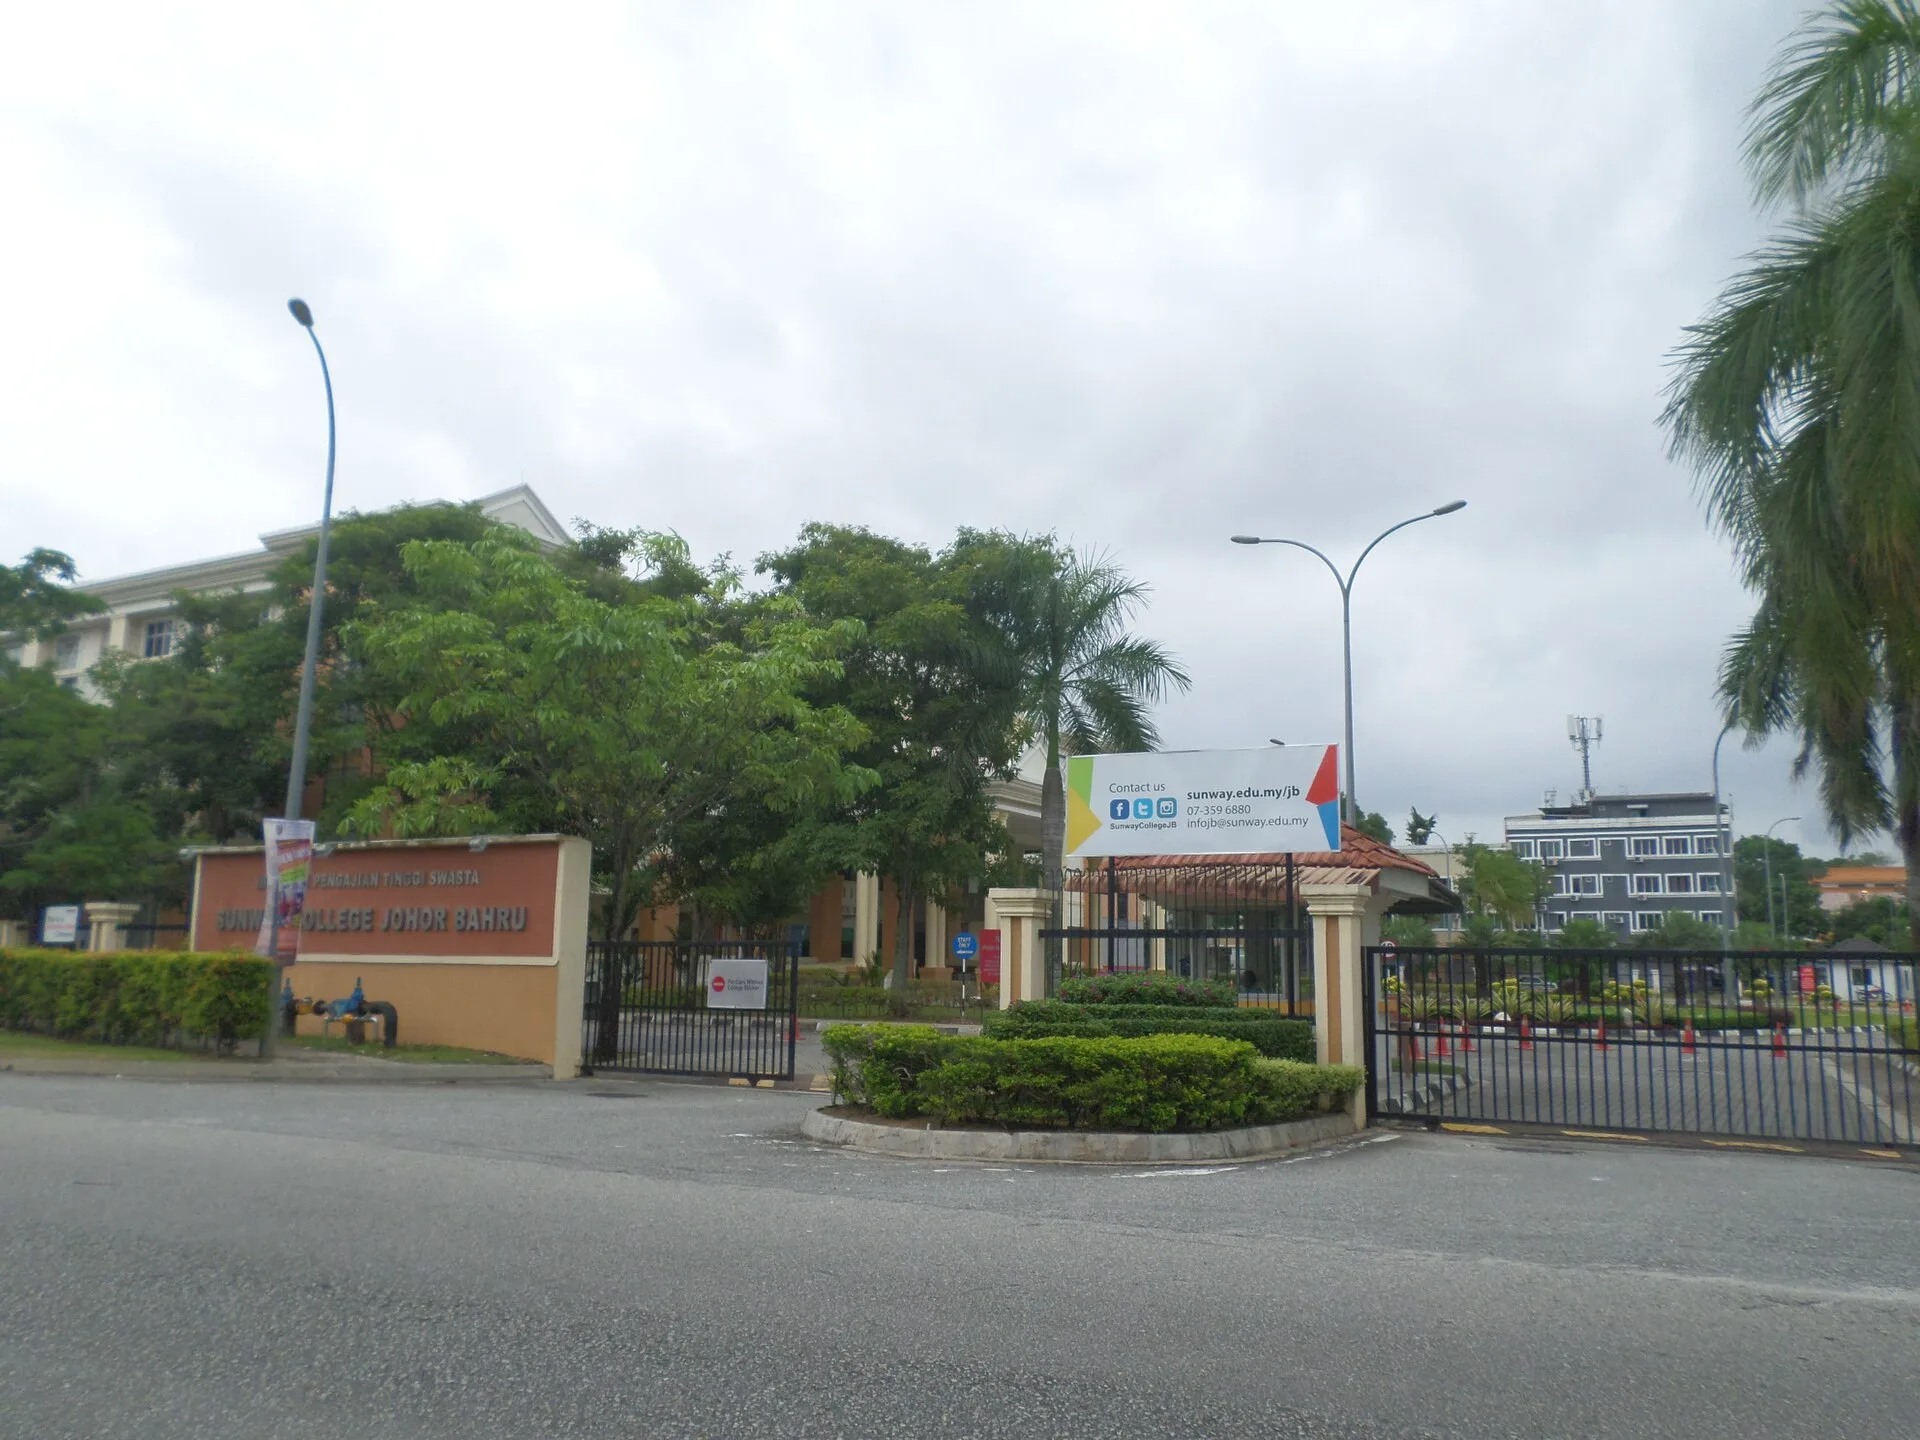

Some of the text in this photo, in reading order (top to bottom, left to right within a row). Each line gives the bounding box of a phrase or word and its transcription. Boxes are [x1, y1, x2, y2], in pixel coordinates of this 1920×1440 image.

[1109, 782, 1166, 794] Contact us
[1187, 786, 1300, 801] sunway.edu.my/jb
[1187, 804, 1251, 816] 07-359 6880
[1110, 820, 1177, 831] SunwayCollegeJB
[1187, 816, 1309, 830] infojb@sunway.edu.my
[313, 872, 381, 888] PENGAJIAN
[383, 871, 426, 886] TINGGI
[429, 868, 481, 885] SWASTA
[302, 908, 375, 932] OLLEGE
[380, 907, 448, 932] JOHOR
[454, 905, 528, 932] BAHRU
